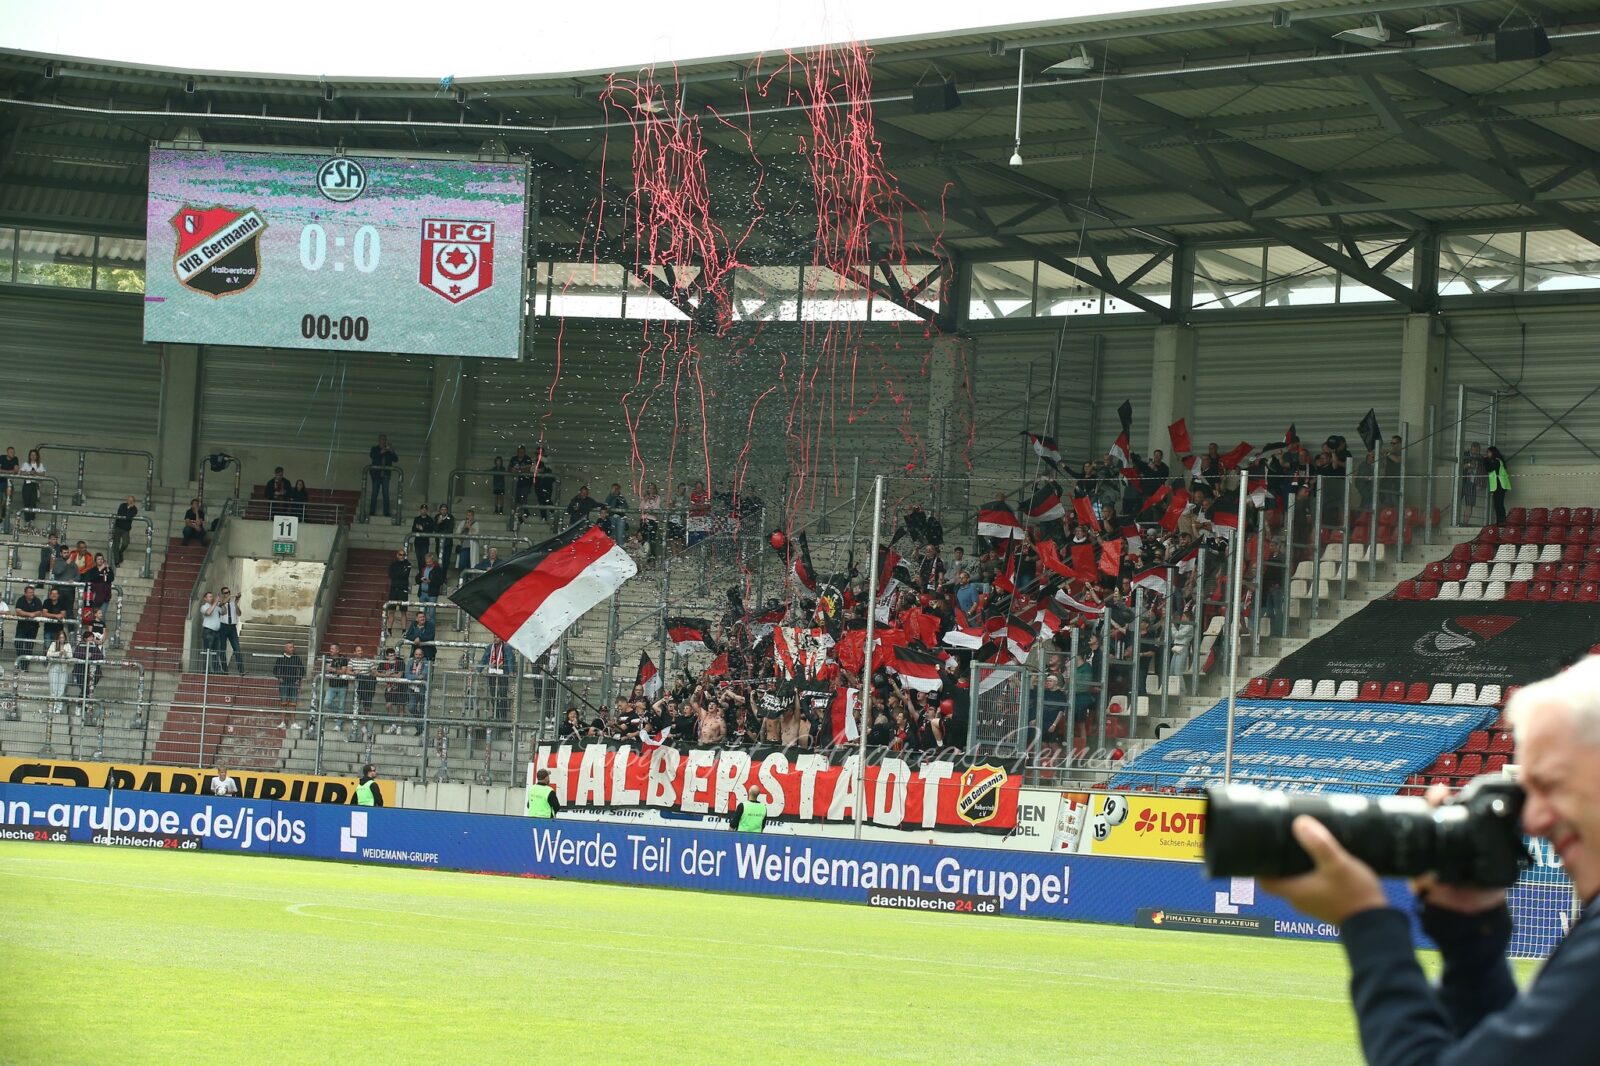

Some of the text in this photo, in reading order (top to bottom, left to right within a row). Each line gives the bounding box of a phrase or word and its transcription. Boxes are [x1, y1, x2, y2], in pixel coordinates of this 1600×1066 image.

[321, 161, 362, 188] FSA
[428, 223, 486, 240] HFC
[179, 217, 259, 273] VfB Germania
[212, 266, 256, 275] Halberstadt
[302, 314, 369, 341] 00:00
[279, 522, 292, 536] 11
[535, 743, 954, 828] HALBERSTADT
[960, 773, 1004, 811] VfB Germania
[609, 809, 645, 818] Saline
[0, 799, 306, 849] n-gruppe.de/jobs
[1094, 823, 1107, 838] 15
[362, 848, 438, 864] WEIDEMANN-GRUPPE
[533, 828, 1070, 911] Werde Teil der Weidemann-Gruppe!
[870, 894, 995, 913] dachbleche24.de
[1165, 915, 1201, 924] FINALTAG
[1219, 919, 1260, 928] AMATEURE
